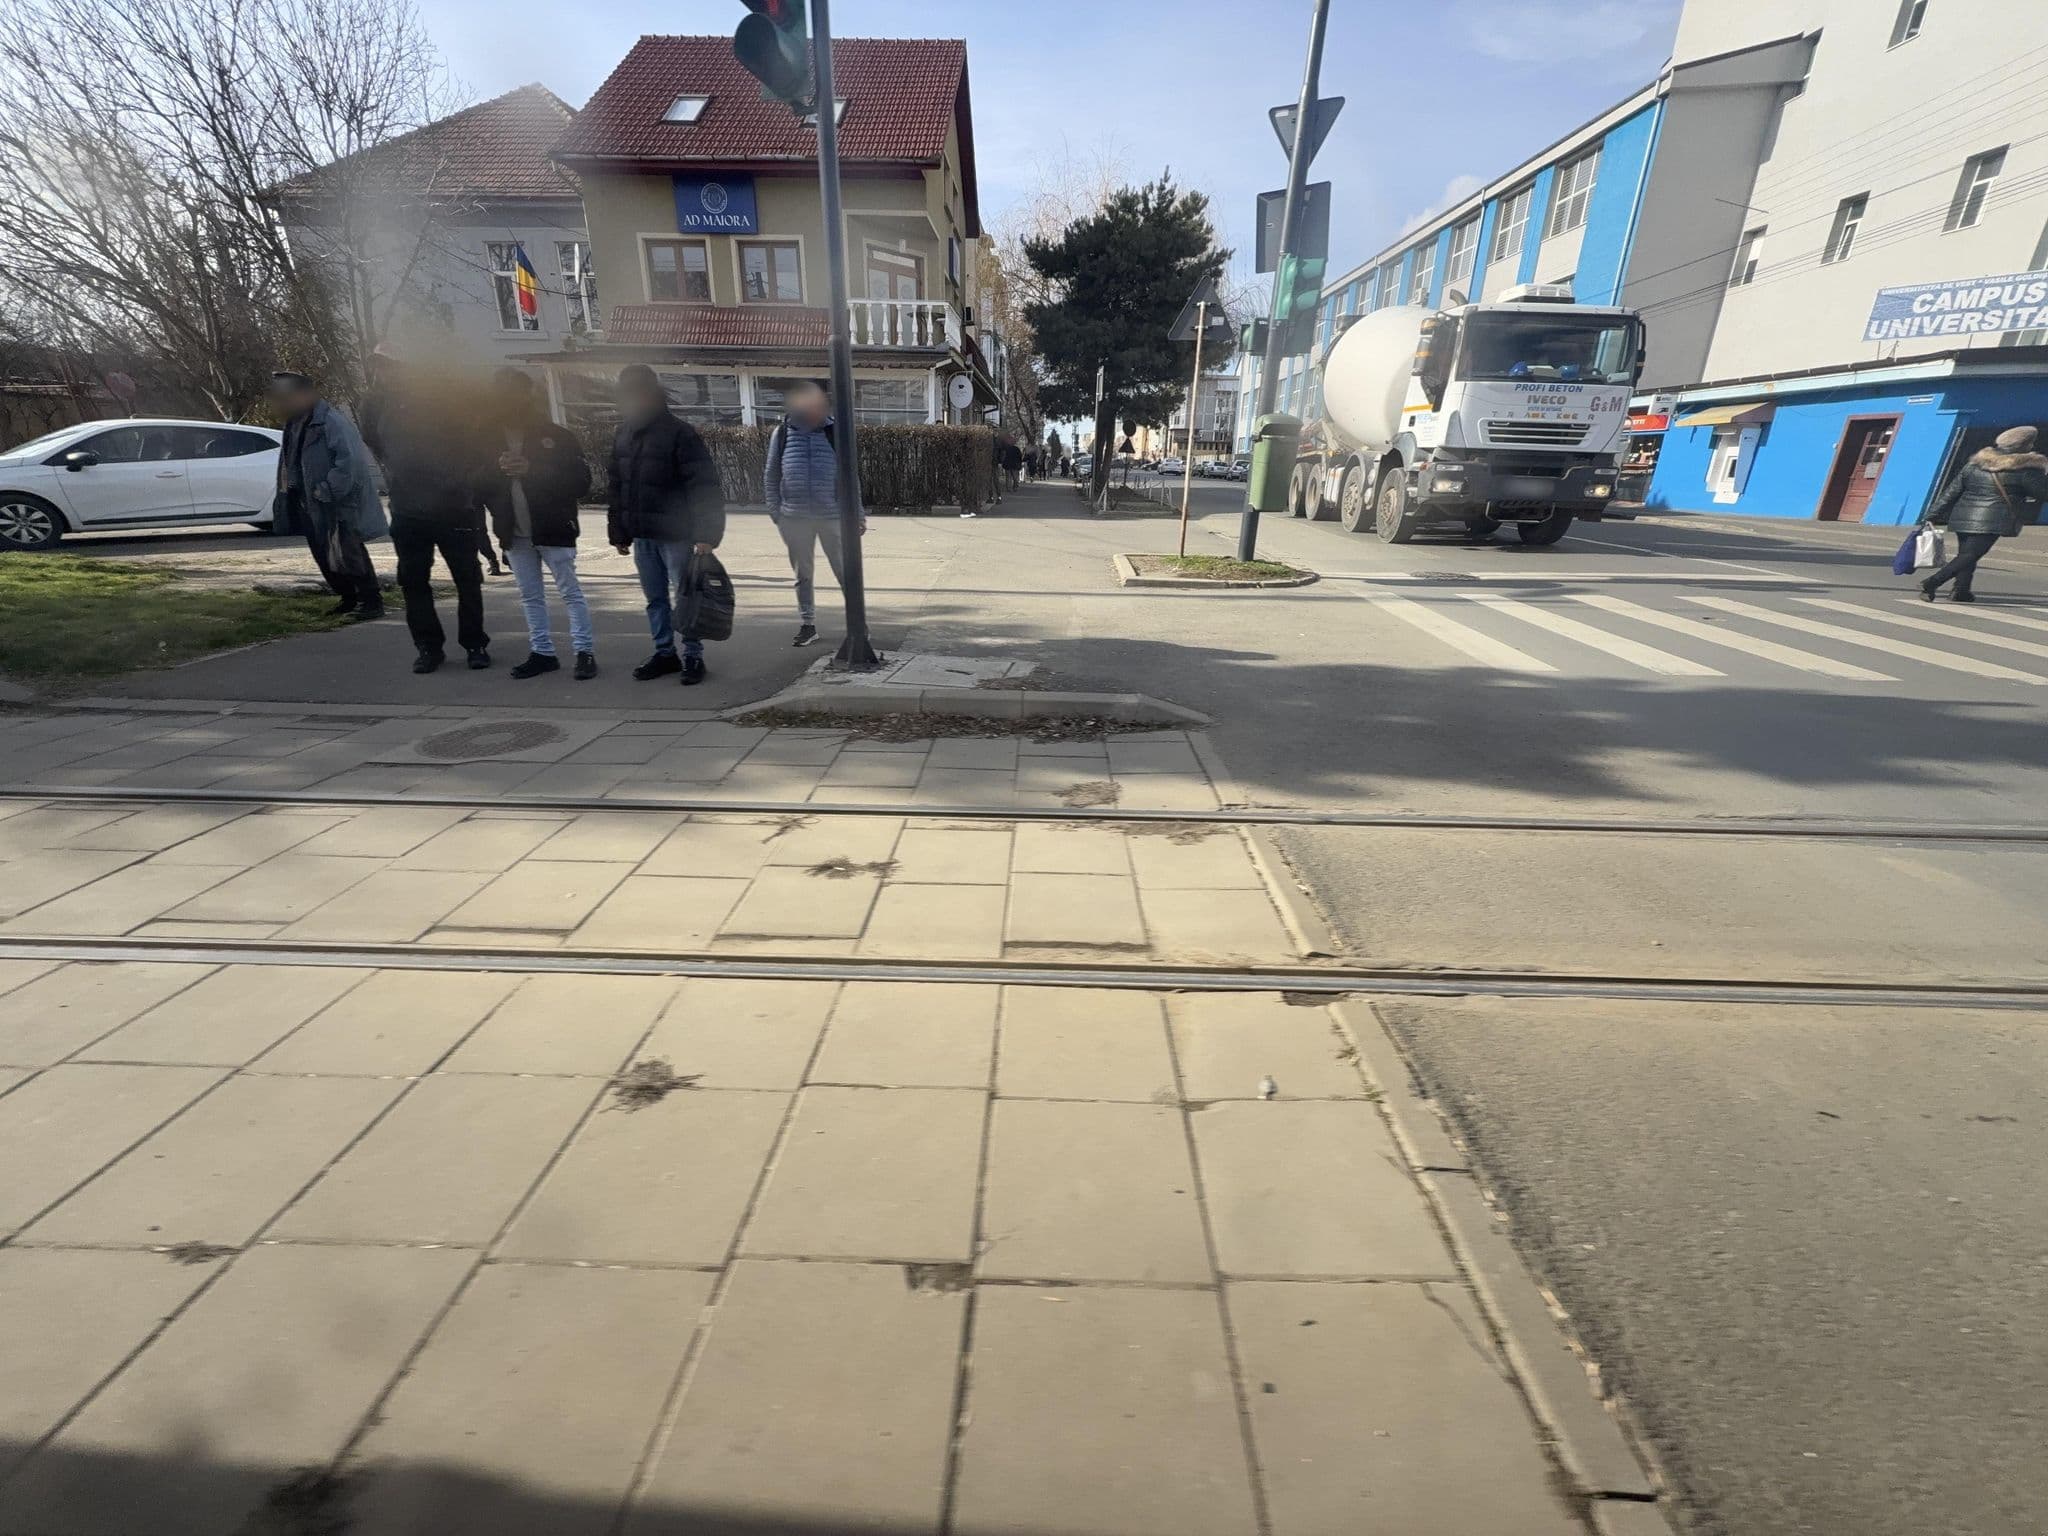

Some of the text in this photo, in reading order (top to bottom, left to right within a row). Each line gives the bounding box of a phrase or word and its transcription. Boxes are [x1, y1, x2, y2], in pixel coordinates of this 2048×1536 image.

[684, 214, 751, 227] AD MAIORA
[1912, 282, 2047, 313] CAMPUS
[1514, 383, 1584, 393] PROFI BETON
[1527, 394, 1567, 405] IVECO
[1590, 396, 1623, 412] G&M
